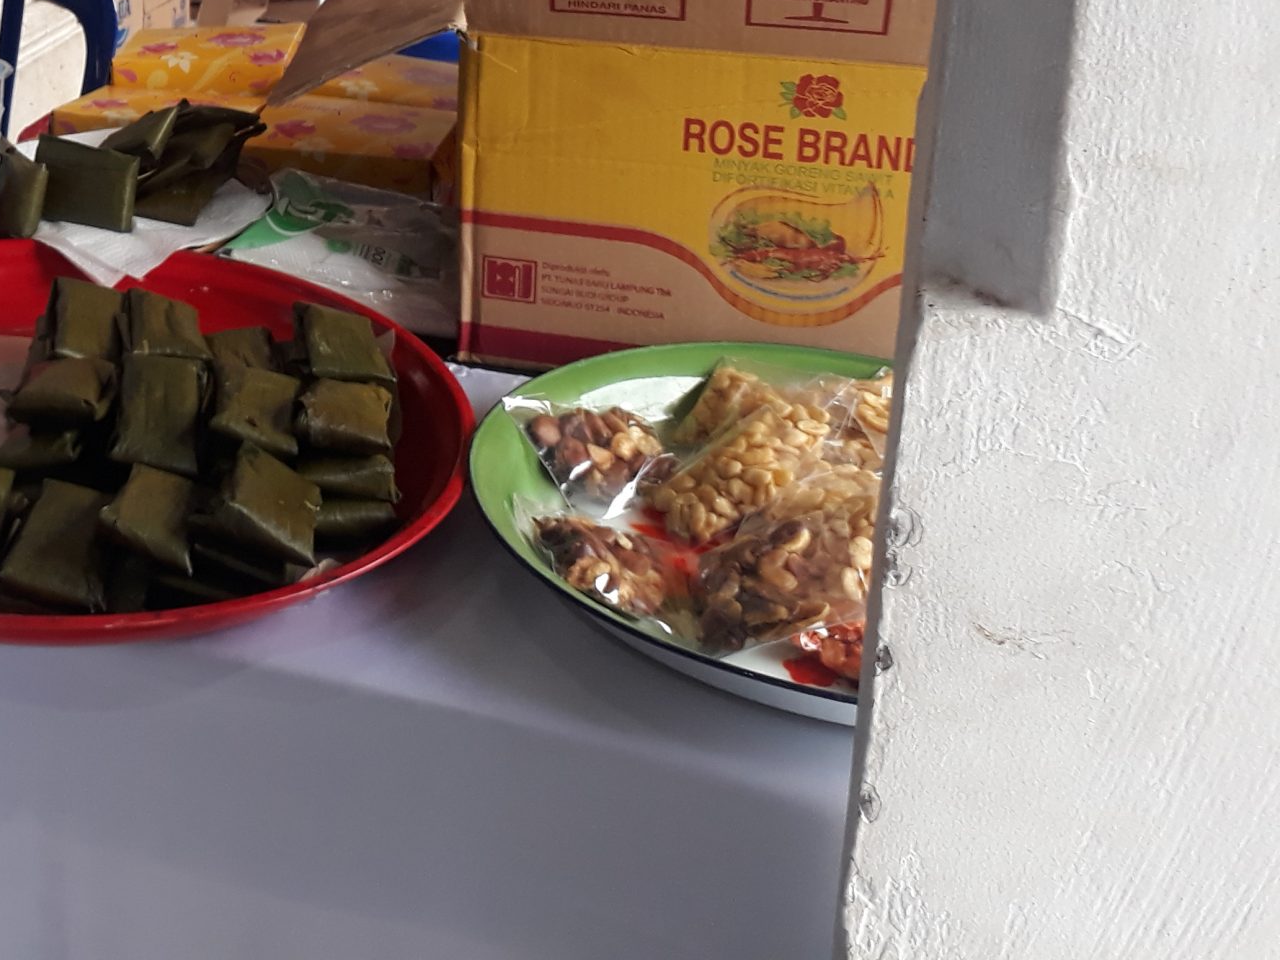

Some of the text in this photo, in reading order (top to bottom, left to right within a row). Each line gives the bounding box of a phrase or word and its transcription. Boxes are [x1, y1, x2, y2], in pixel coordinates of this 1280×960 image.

[568, 0, 666, 14] HINDARI PANAS
[682, 117, 784, 160] ROSE
[713, 158, 769, 173] MINYAK
[774, 163, 841, 181] GORENG
